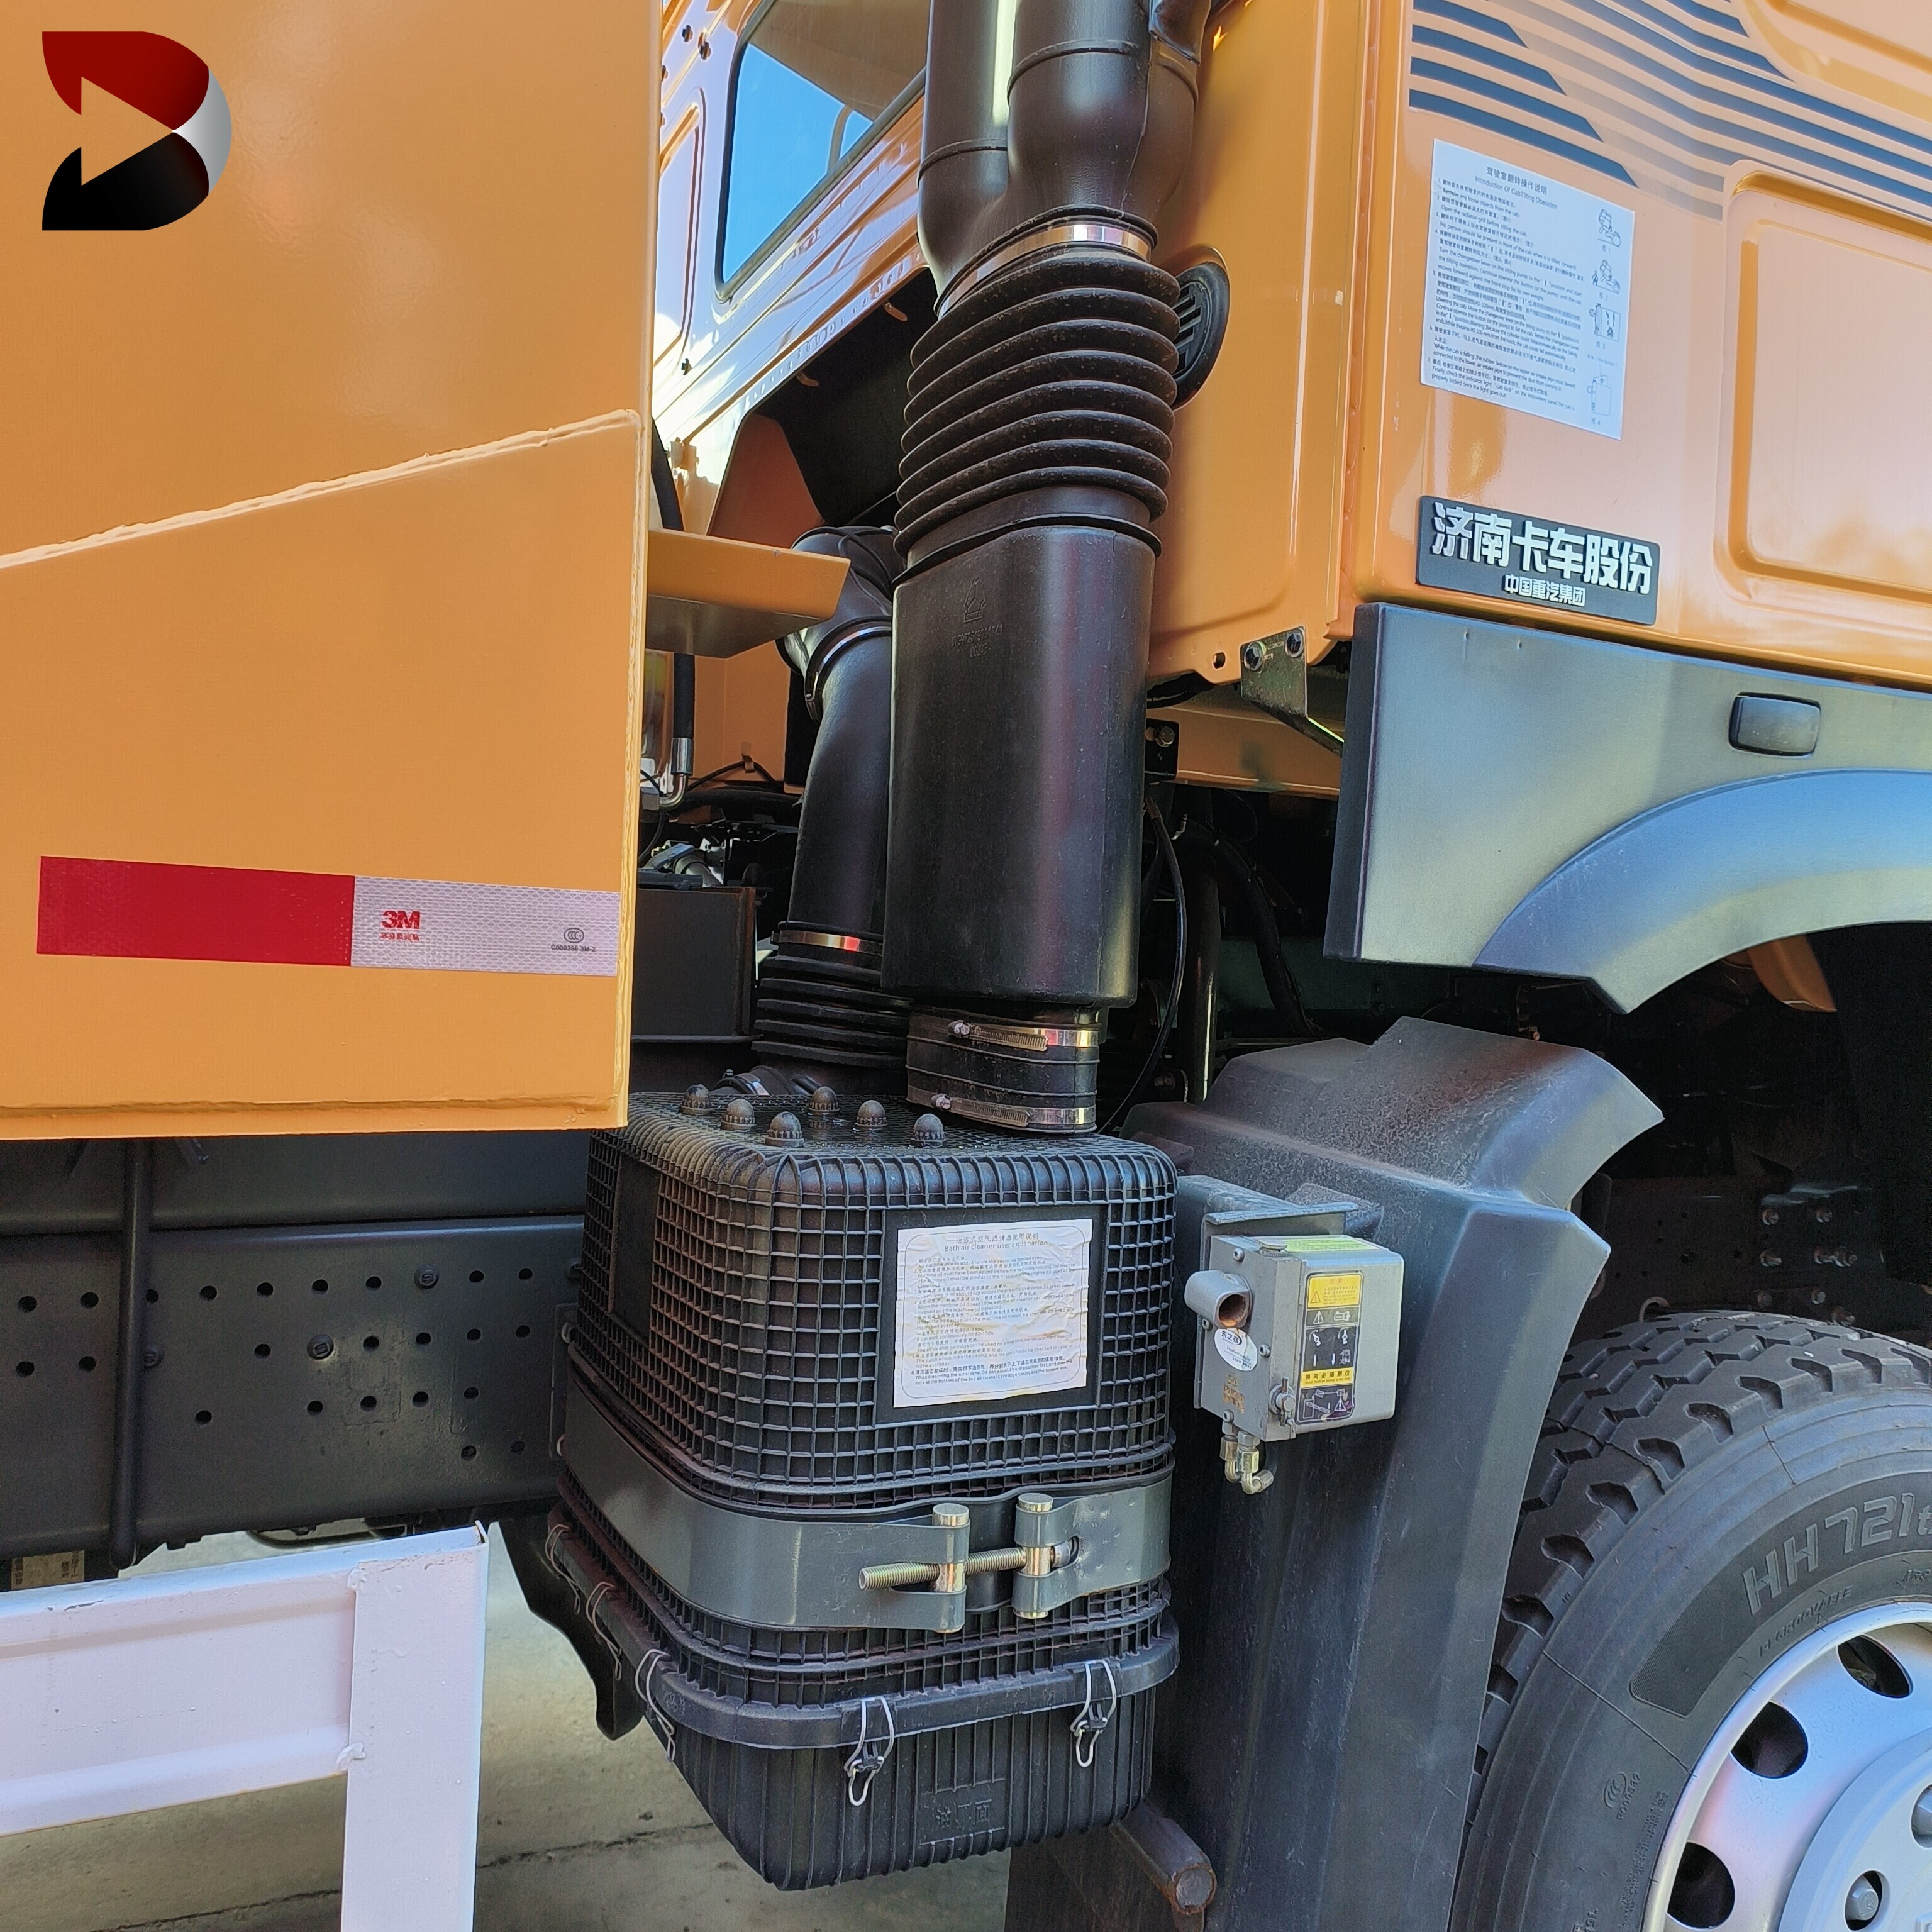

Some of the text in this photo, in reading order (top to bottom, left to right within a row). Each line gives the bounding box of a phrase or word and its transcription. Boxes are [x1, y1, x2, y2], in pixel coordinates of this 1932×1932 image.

[1475, 175, 1502, 190] Introduction
[1535, 197, 1557, 211] Operation
[1487, 165, 1547, 196] 驾驶室翻转操作说明
[1442, 187, 1458, 197] Remove
[1468, 196, 1478, 204] loose
[1479, 199, 1493, 210] objects
[1494, 204, 1503, 213] from
[1441, 203, 1452, 213] Open
[1487, 219, 1499, 228] before
[1447, 224, 1461, 233] person
[1462, 228, 1475, 236] should
[1482, 235, 1497, 245] present
[1533, 251, 1543, 259] when
[1453, 267, 1468, 277] forward
[1501, 283, 1509, 291] stop
[1480, 268, 1496, 277] Continue
[1431, 372, 1448, 382] properly
[1432, 502, 1653, 594] 济南卡车股份
[1504, 574, 1586, 607] 中国重汽集团
[382, 910, 421, 929] 3M
[1011, 1240, 1048, 1248] explanation
